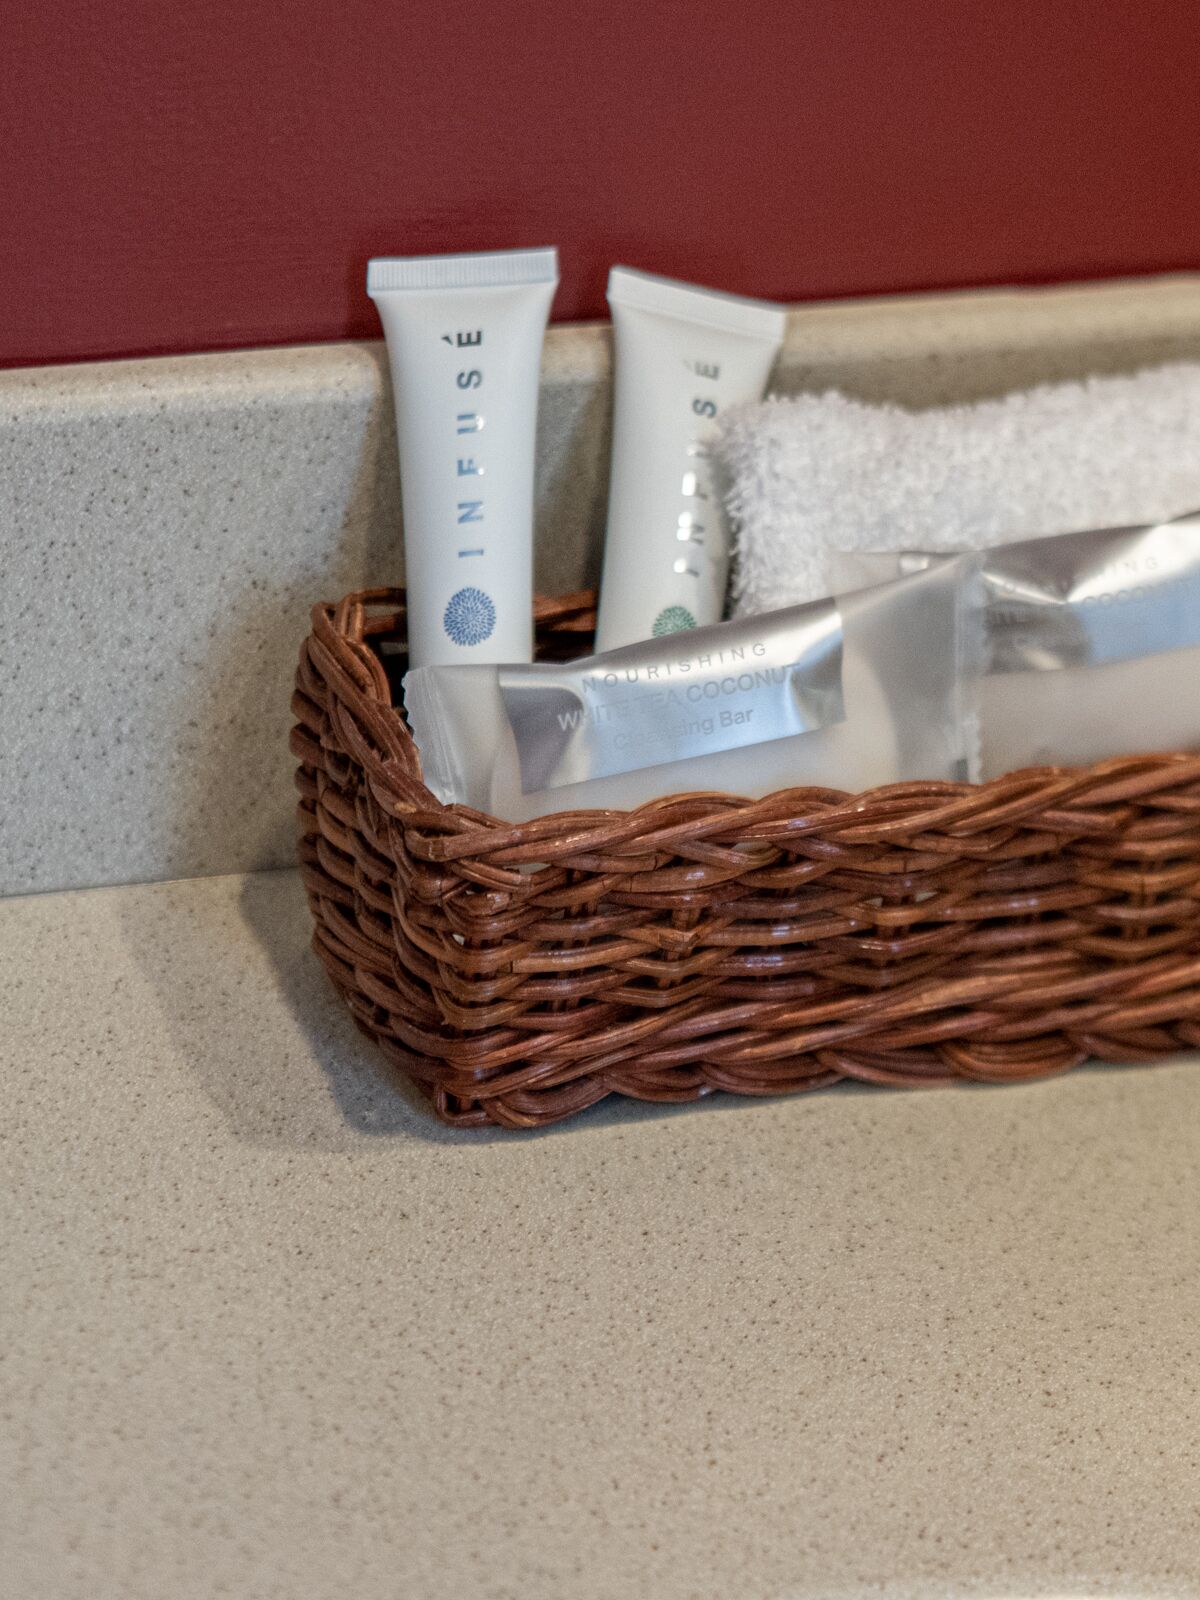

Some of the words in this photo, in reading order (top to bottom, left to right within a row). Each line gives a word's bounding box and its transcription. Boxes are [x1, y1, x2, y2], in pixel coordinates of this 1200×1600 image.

[583, 643, 767, 692] NOURISHING
[686, 663, 800, 702] COCONUT
[719, 708, 754, 729] Bar
